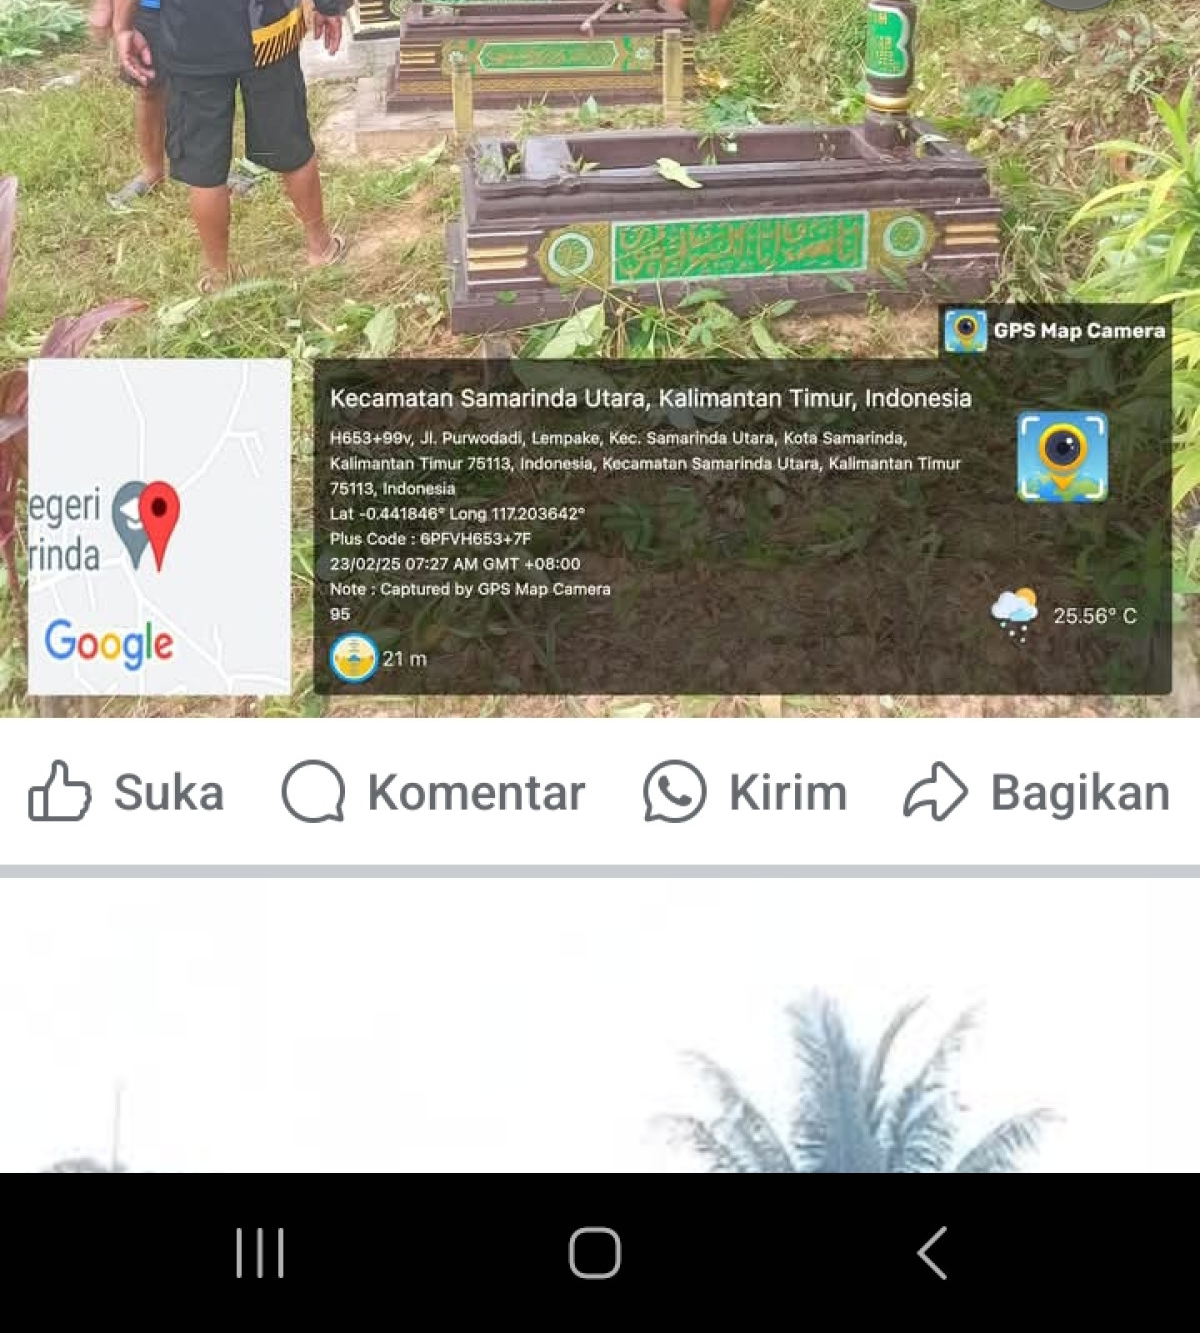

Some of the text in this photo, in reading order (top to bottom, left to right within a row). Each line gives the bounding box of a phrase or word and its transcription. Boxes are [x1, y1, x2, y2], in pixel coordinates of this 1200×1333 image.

[114, 772, 224, 812] Suka
[369, 774, 586, 812] Komentar
[731, 773, 846, 812] Kirim
[992, 772, 1169, 821] Bagikan
